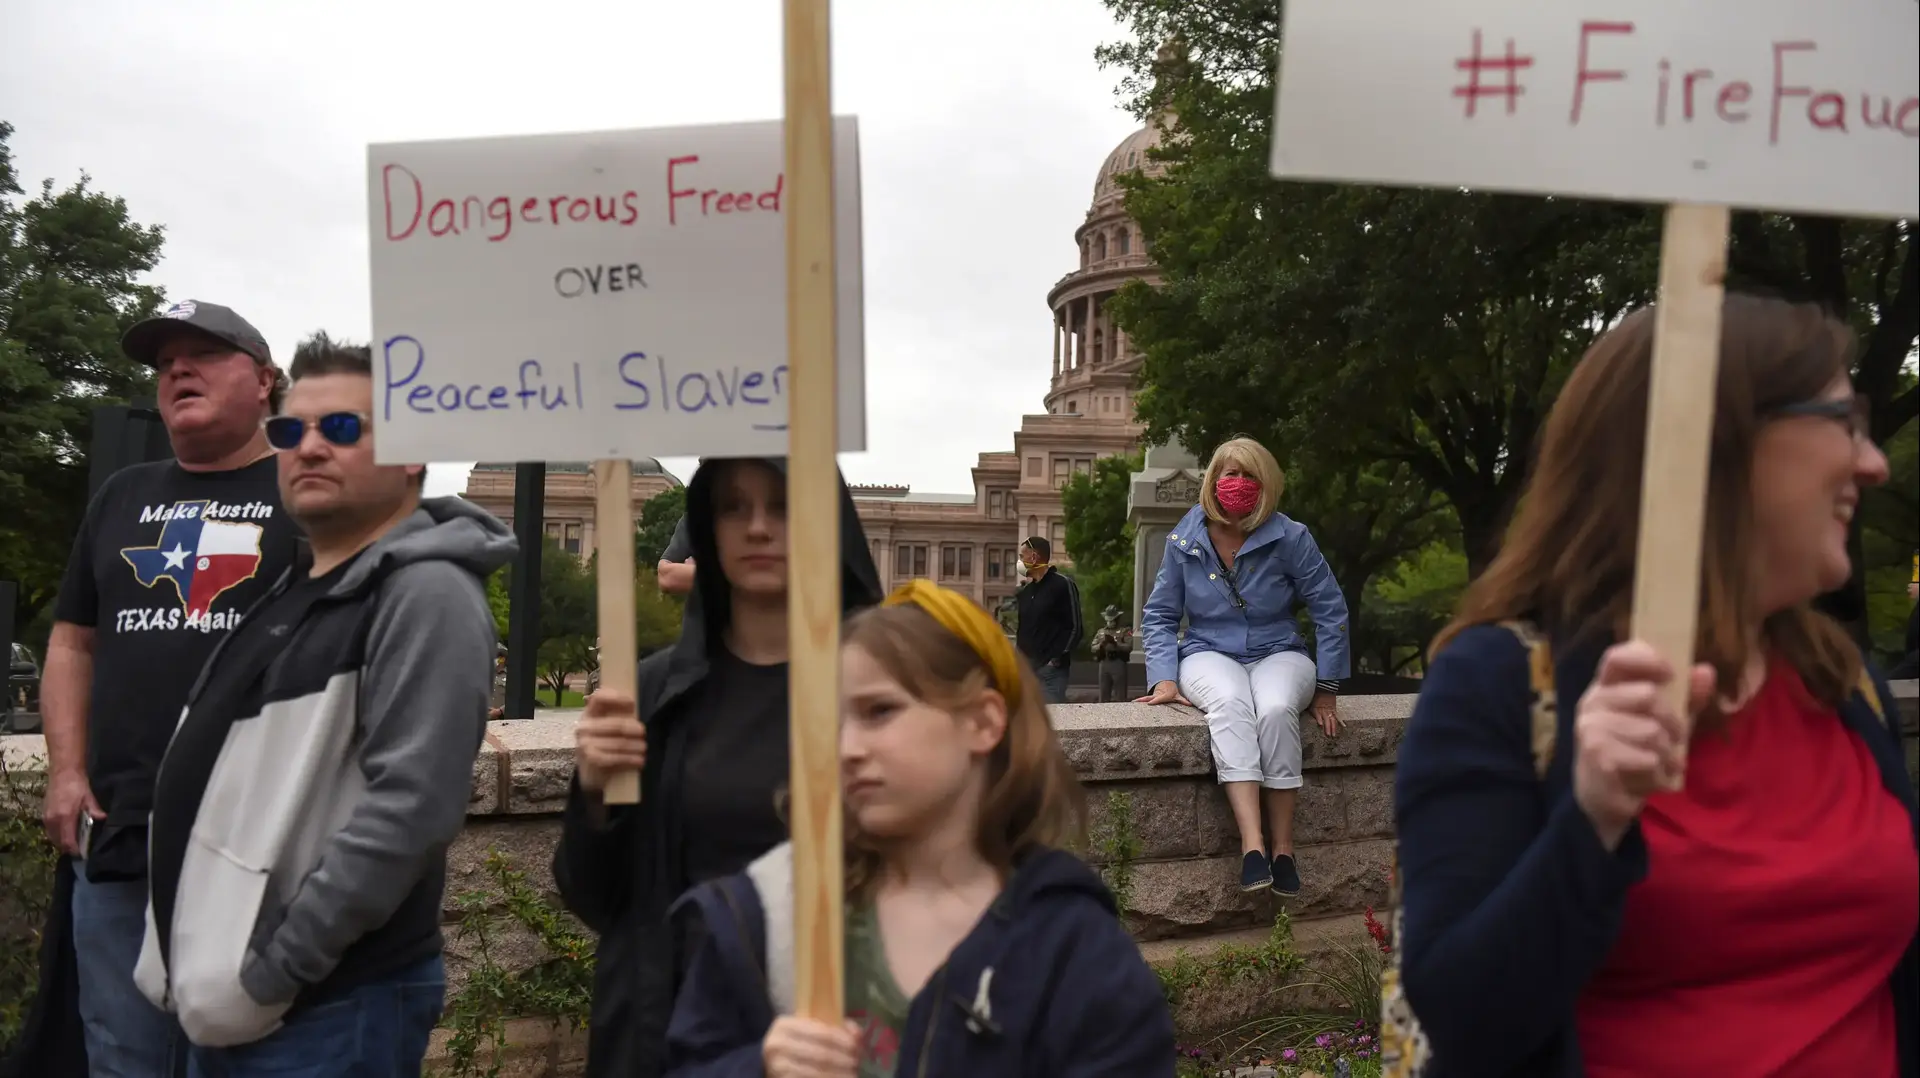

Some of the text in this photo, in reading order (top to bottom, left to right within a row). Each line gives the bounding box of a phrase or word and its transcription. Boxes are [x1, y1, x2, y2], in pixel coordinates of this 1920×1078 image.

[382, 155, 785, 242] Dangerous Freed
[554, 263, 648, 299] OVER
[384, 335, 789, 431] Peaceful Slaver
[139, 501, 273, 523] Make Austin
[116, 608, 181, 633] TEXAS
